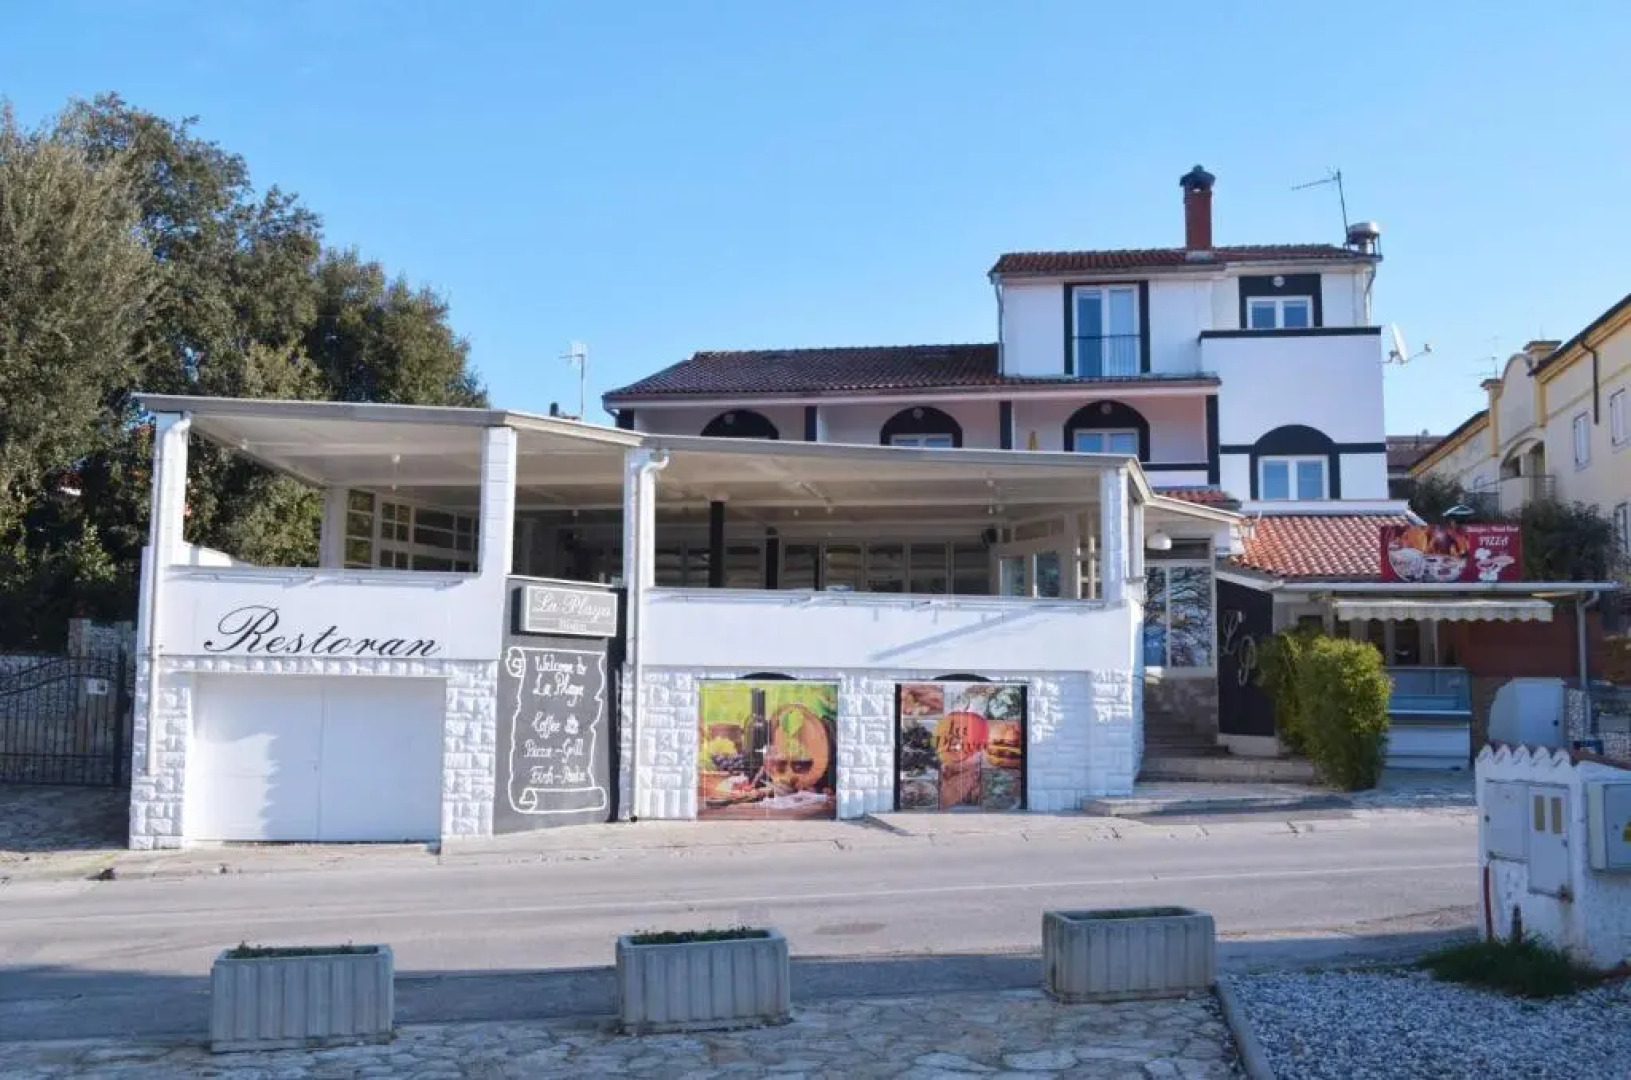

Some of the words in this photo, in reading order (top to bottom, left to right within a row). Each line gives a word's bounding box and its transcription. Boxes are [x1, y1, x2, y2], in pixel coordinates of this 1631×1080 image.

[532, 591, 560, 612] La
[562, 594, 611, 623] Playa
[203, 604, 441, 656] Restoran
[533, 672, 551, 696] La
